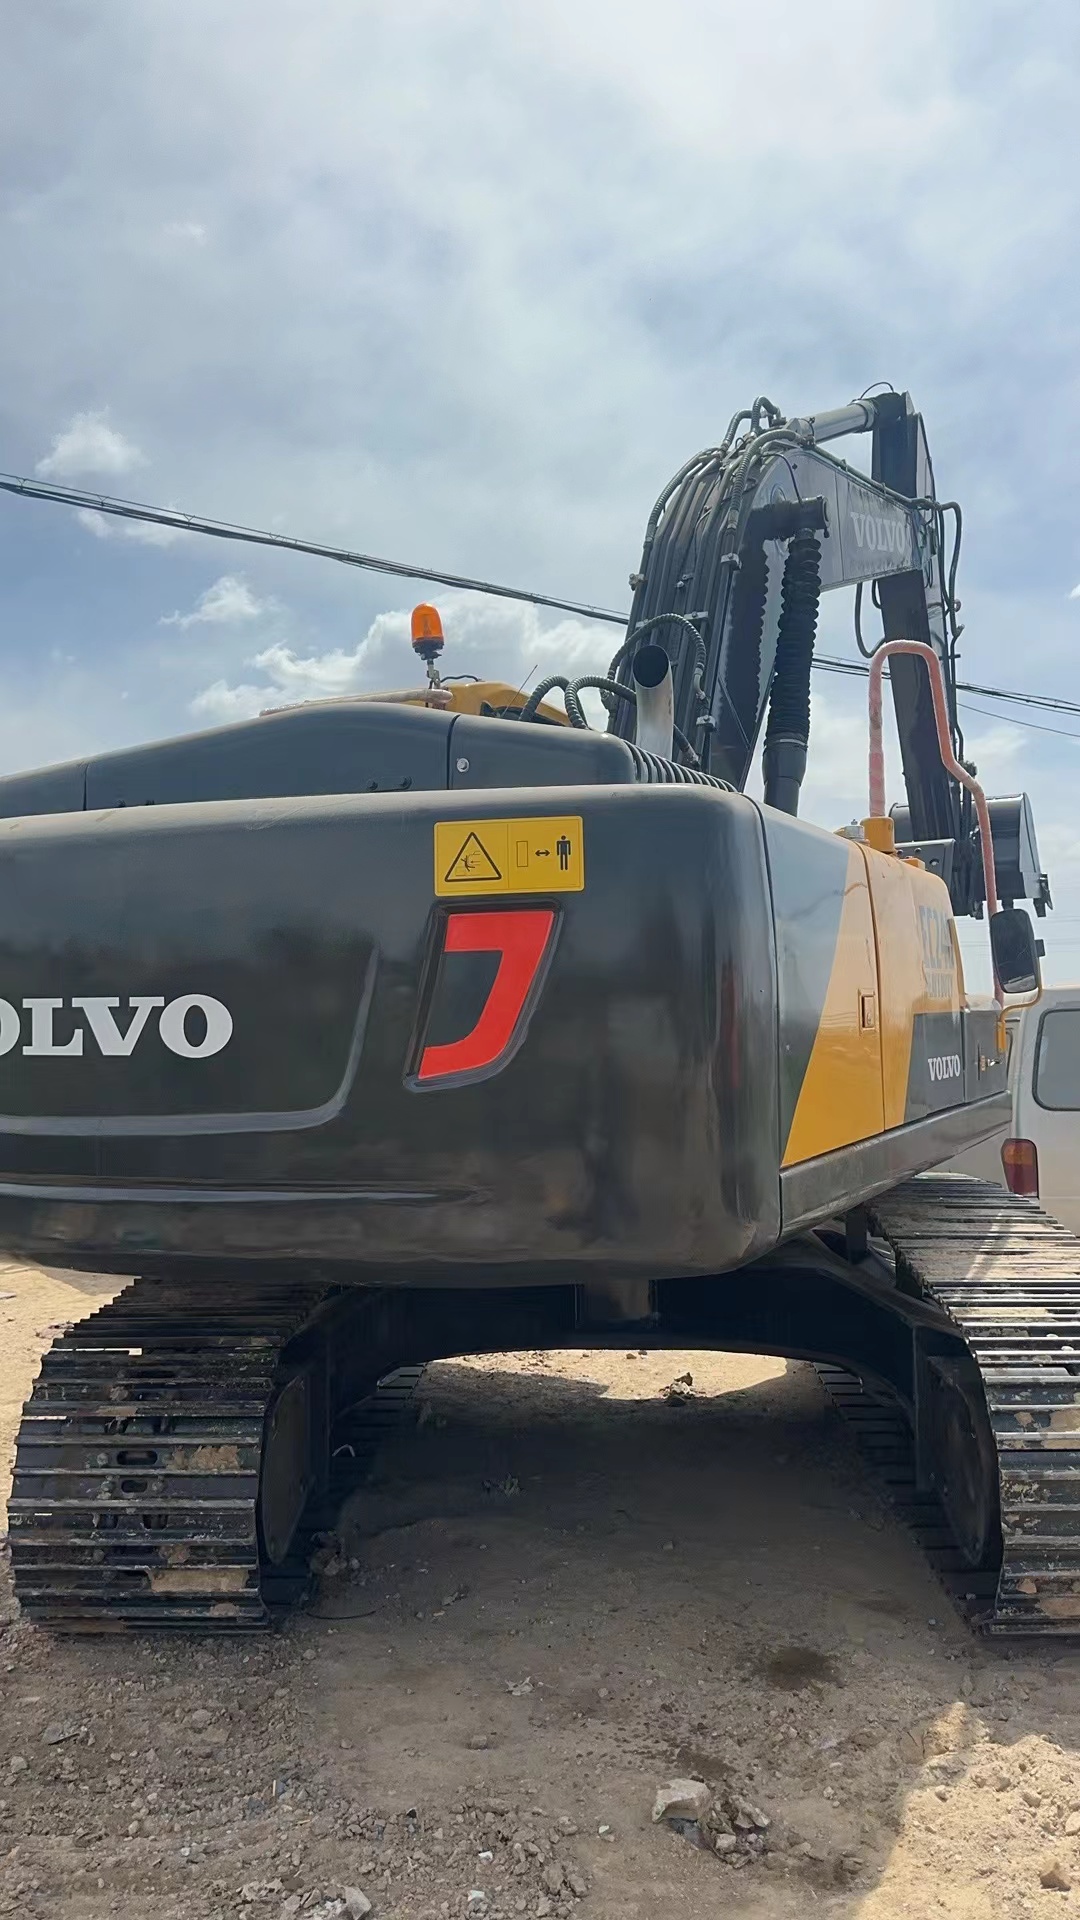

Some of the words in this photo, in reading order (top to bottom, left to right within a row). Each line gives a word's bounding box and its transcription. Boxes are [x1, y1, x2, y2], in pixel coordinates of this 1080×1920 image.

[850, 511, 905, 554] VOLVO
[0, 993, 234, 1059] LVO
[927, 1054, 960, 1081] VOLVO
